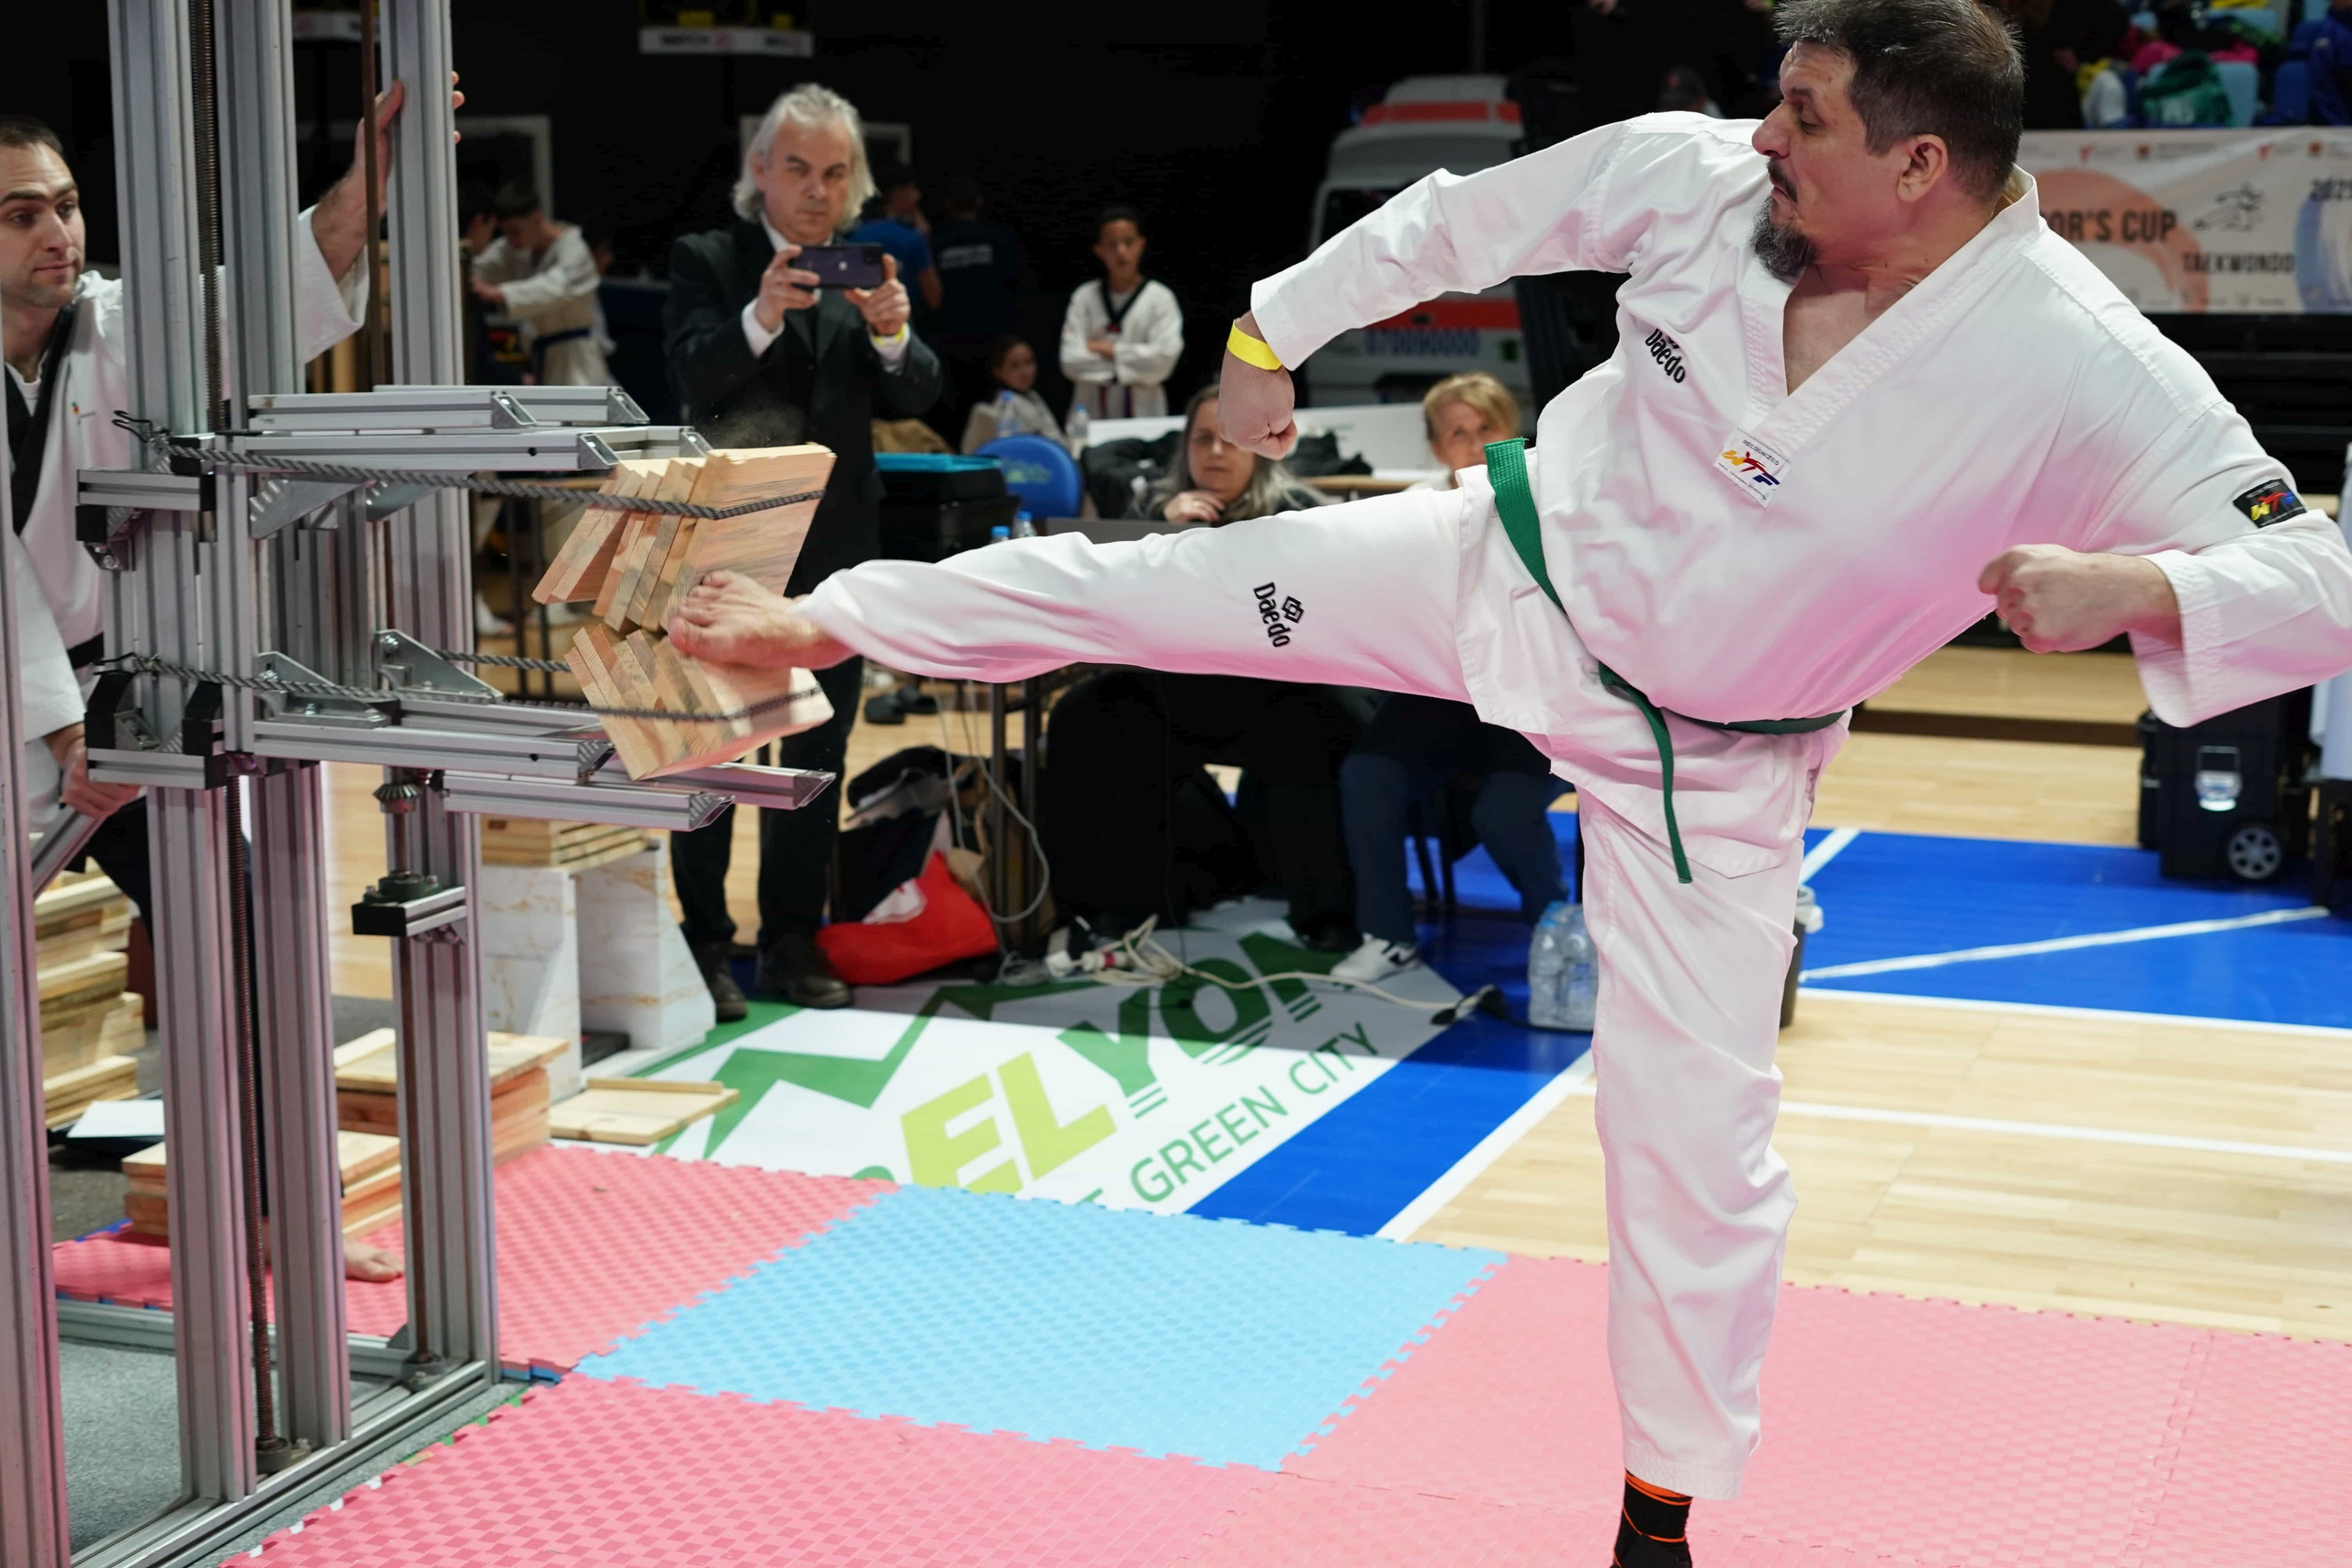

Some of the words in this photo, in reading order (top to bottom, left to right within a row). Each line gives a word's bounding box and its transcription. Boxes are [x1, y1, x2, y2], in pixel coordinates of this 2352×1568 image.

[2041, 209, 2111, 243] OR'S
[2121, 209, 2177, 243] CUP
[2183, 251, 2295, 274] TAEKWONDO
[1645, 328, 1686, 383] Daedo
[1253, 581, 1292, 648] Daedo
[1129, 1085, 1289, 1203] GREEN
[1288, 1021, 1380, 1095] CITY
